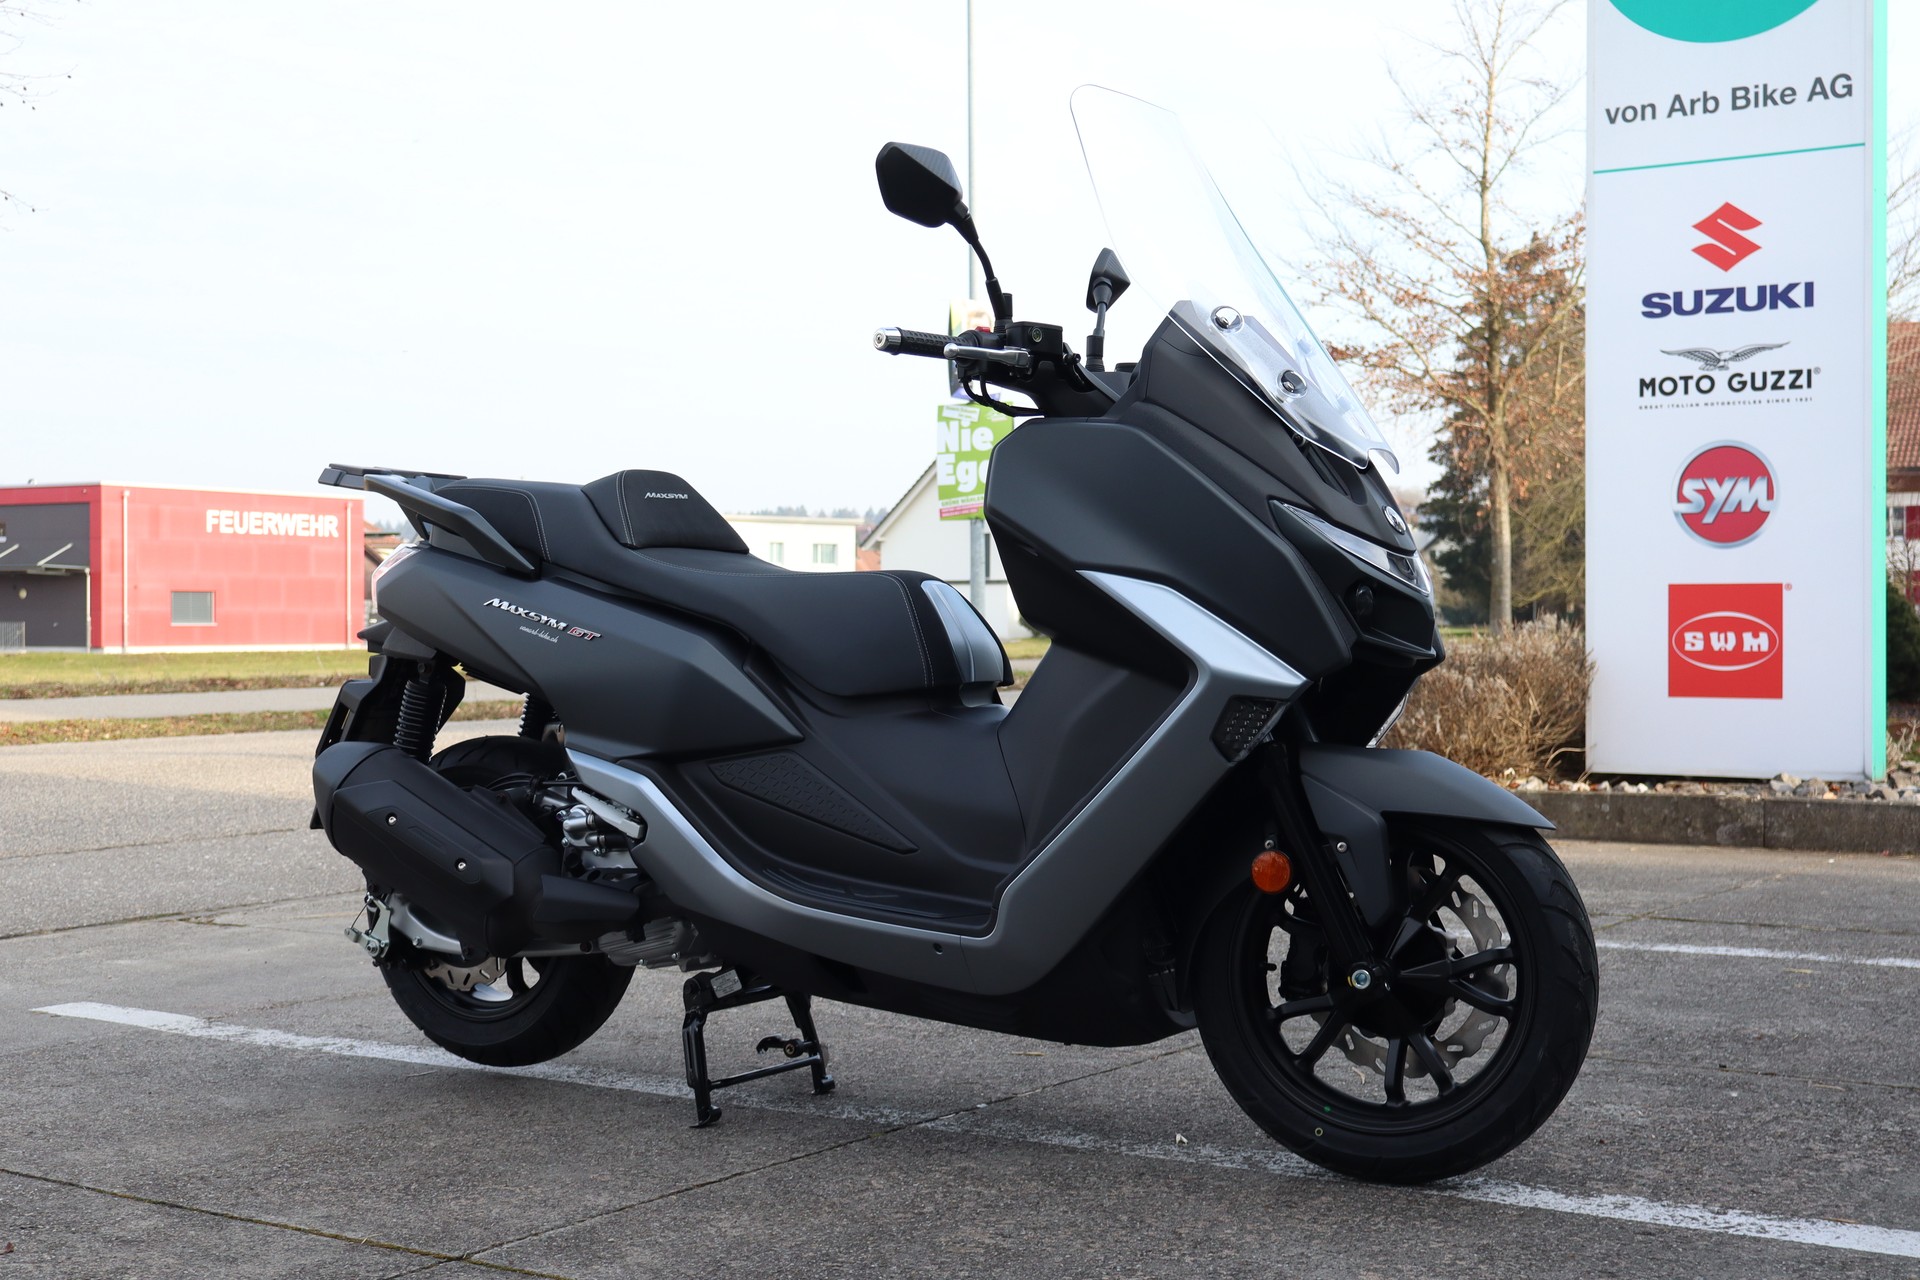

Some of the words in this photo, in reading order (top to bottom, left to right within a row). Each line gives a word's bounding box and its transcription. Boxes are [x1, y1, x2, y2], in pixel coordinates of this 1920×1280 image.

[1605, 102, 1657, 124] von
[1666, 91, 1720, 118] Arb
[1731, 83, 1797, 112] Bike
[1807, 73, 1853, 102] AG
[1641, 281, 1814, 319] SUZUKI
[1639, 374, 1715, 397] MOTO
[1727, 368, 1813, 393] GUZZI
[937, 418, 994, 453] Nie
[644, 491, 689, 500] MAXSYM
[1674, 476, 1777, 525] SYM
[206, 509, 339, 538] FEUERWEHR
[483, 597, 569, 631] MAXSYM
[567, 626, 602, 641] GT
[1683, 631, 1770, 653] SWM
